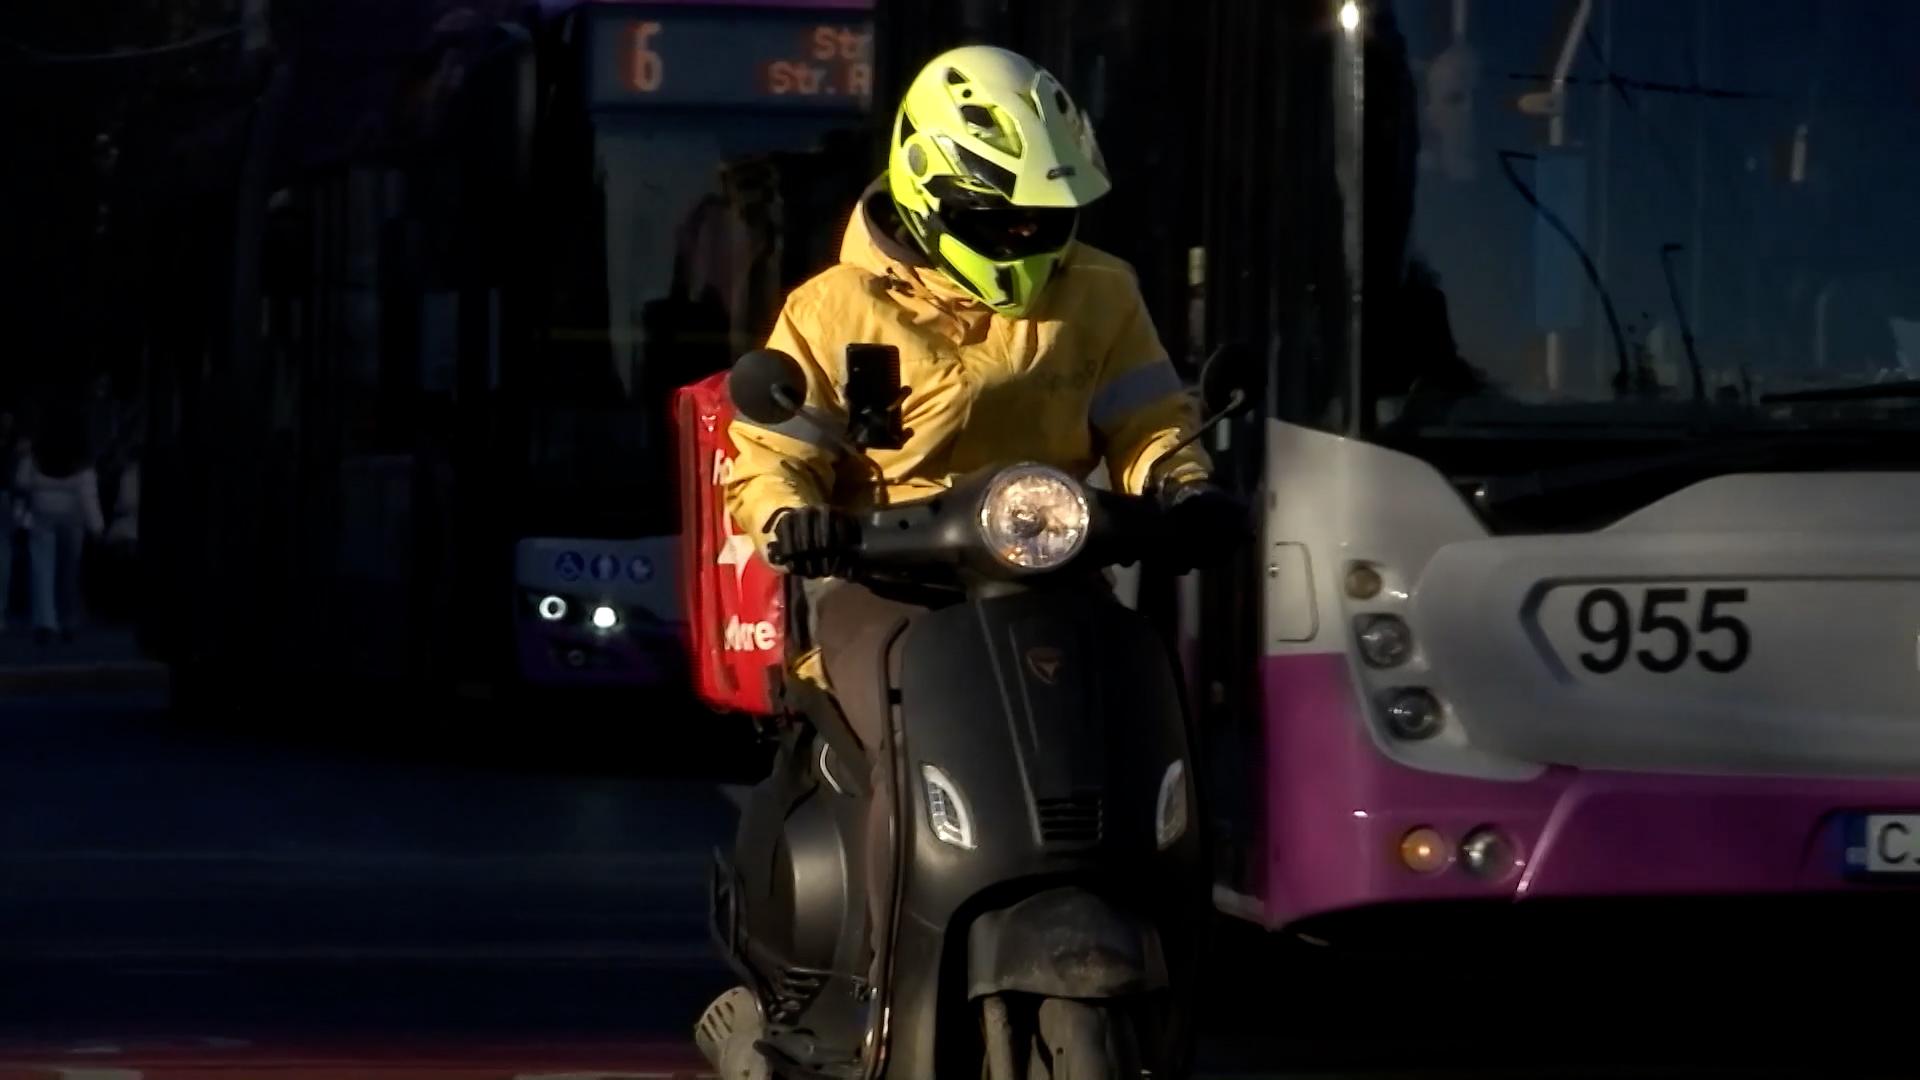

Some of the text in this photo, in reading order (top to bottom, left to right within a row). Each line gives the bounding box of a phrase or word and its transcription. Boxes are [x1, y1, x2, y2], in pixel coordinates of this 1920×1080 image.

[631, 21, 663, 92] 6
[1577, 588, 1750, 674] 955
[1877, 820, 1920, 866] C
